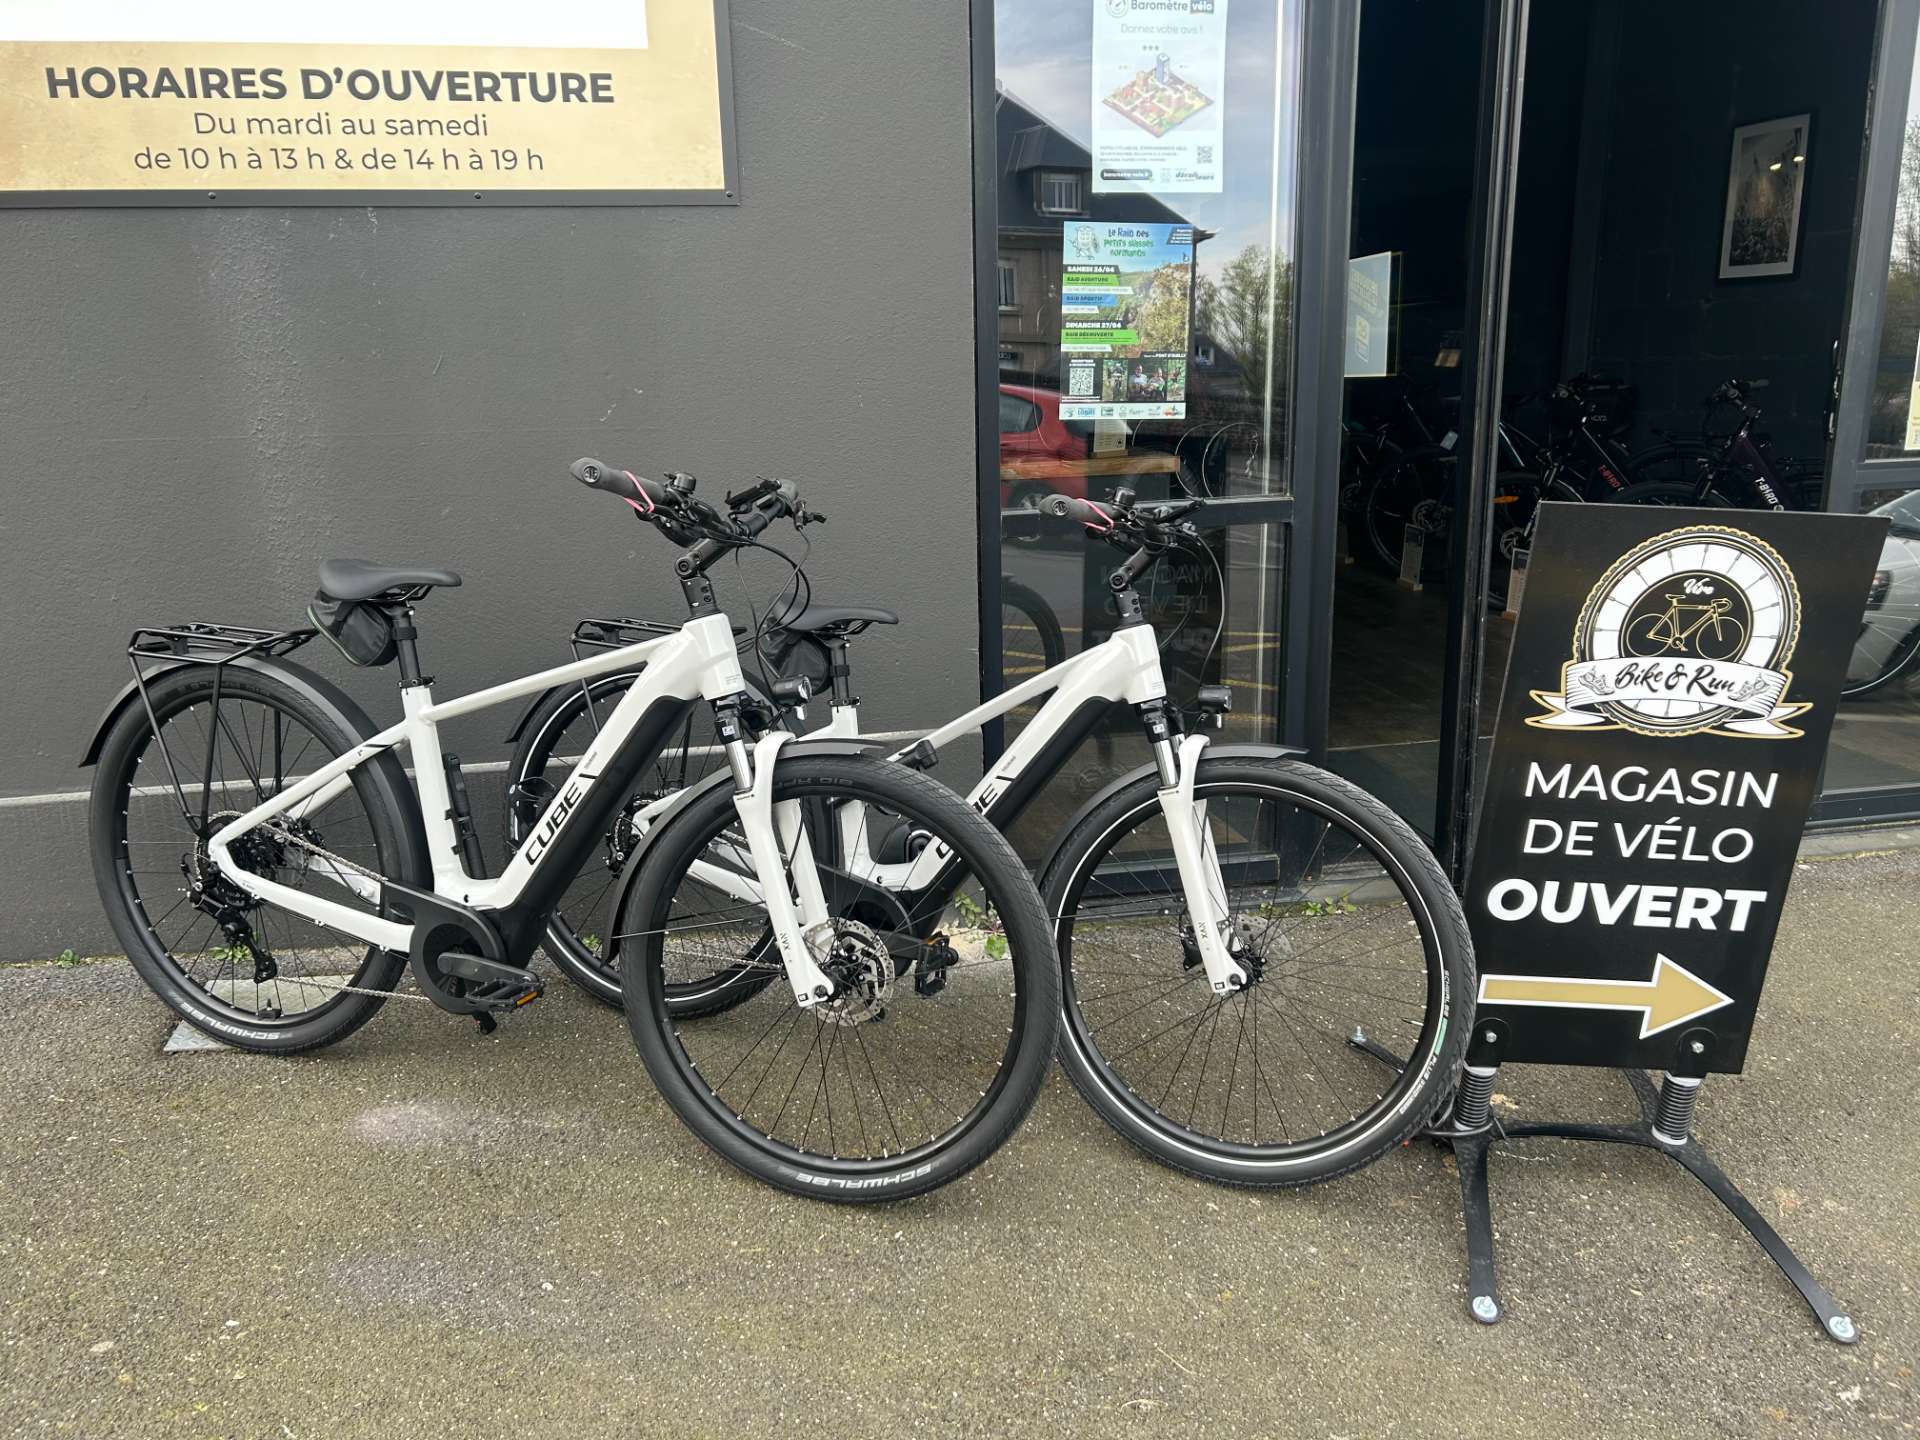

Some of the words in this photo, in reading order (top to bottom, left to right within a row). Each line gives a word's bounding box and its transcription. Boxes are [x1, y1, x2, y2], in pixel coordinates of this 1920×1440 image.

[1131, 0, 1188, 10] Baromètre
[1121, 24, 1154, 33] Donnez
[45, 67, 287, 100] HORAIRES
[301, 68, 614, 103] D'OUVERTURE
[194, 113, 235, 134] Du
[247, 113, 331, 135] mardi
[341, 119, 375, 135] au
[385, 114, 488, 136] samedi
[134, 147, 171, 170] de
[178, 148, 209, 169] 10
[218, 147, 237, 169] h
[247, 147, 263, 170] à
[269, 149, 298, 170] 13
[307, 148, 325, 169] h
[334, 149, 354, 170] &
[361, 148, 397, 170] de
[403, 149, 434, 170] 14
[442, 149, 459, 170] h
[469, 149, 483, 170] à
[490, 149, 518, 170] 19
[527, 149, 544, 170] h
[1754, 477, 1779, 505] T-BIRD
[1614, 662, 1663, 693] Bike
[1664, 663, 1688, 691] &
[1686, 664, 1736, 697] Run
[1524, 761, 1779, 809] MAGASIN
[525, 782, 582, 865] CUBE
[1523, 818, 1599, 856] DE
[1613, 816, 1754, 864] VÉLO
[1487, 878, 1768, 932] OUVERT
[181, 1001, 281, 1041] SCHWALBE
[795, 1164, 932, 1189] SCHWALBE
